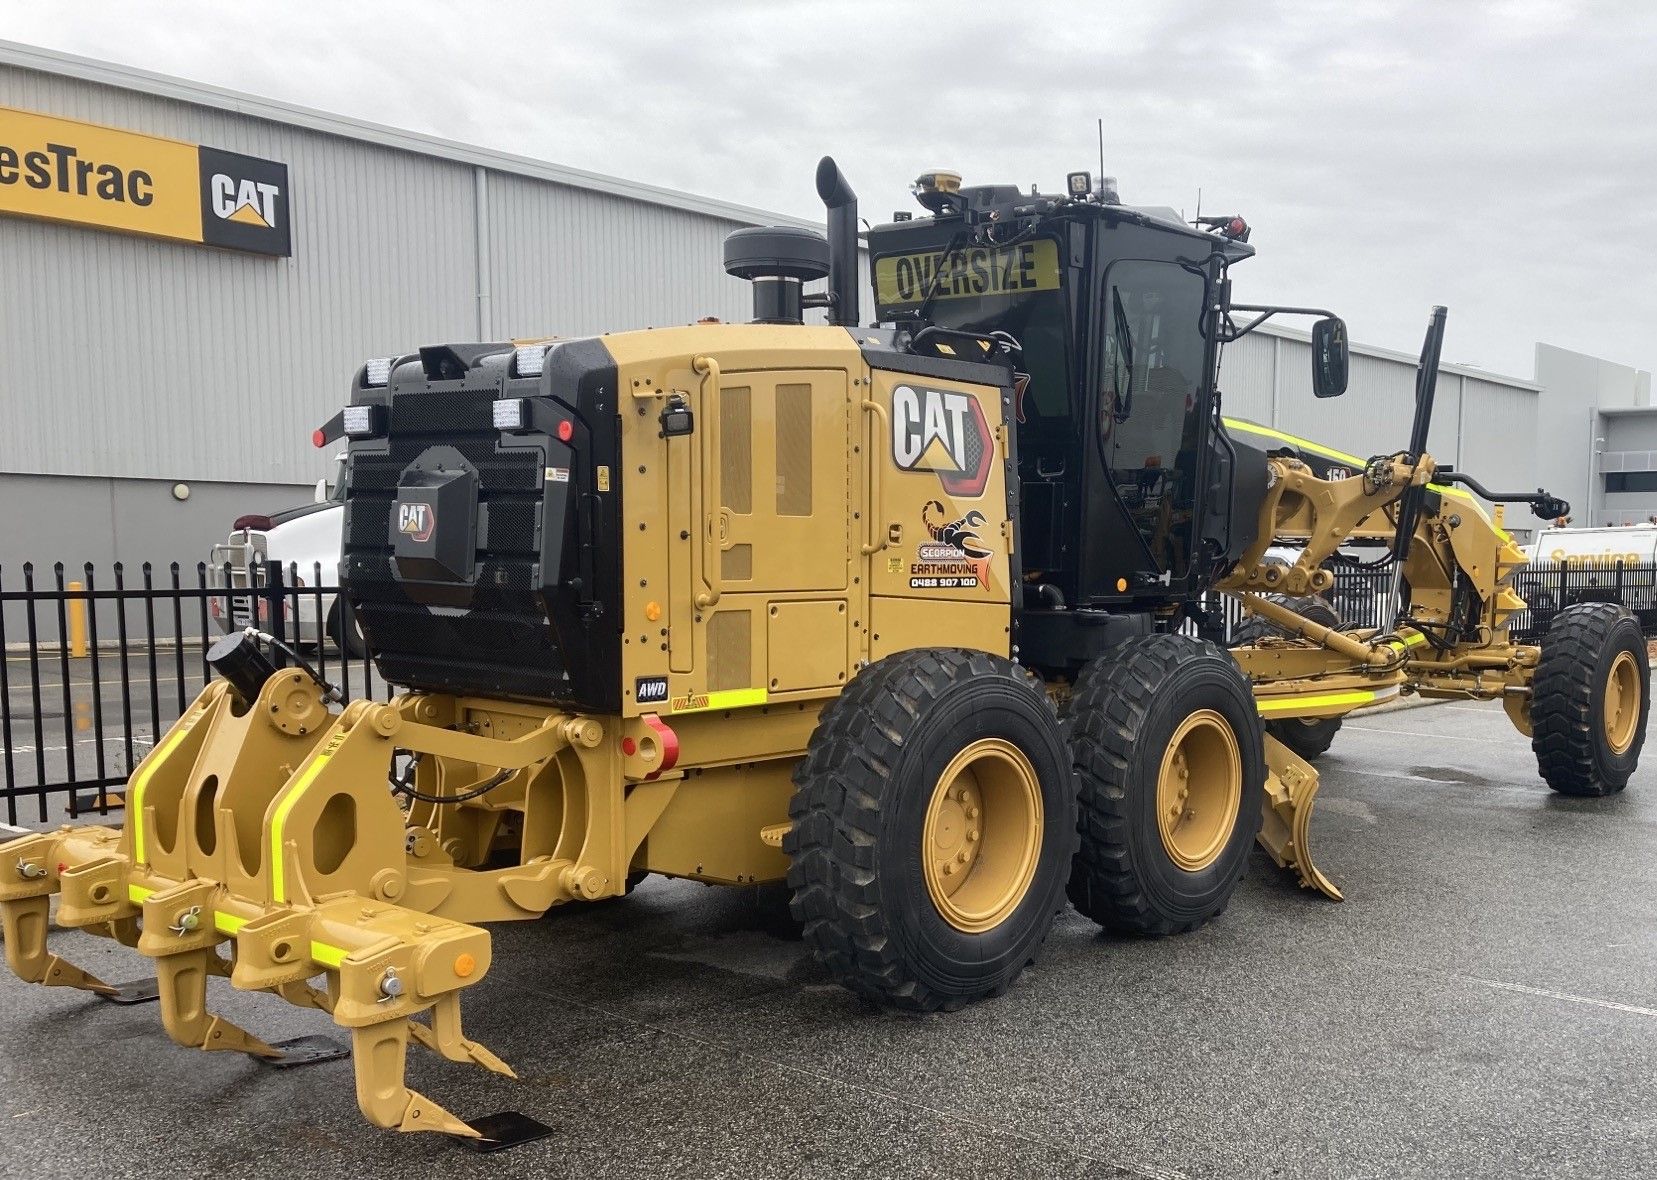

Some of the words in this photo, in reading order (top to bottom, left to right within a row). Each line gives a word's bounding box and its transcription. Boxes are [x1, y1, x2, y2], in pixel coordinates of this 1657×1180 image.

[210, 173, 279, 228] CAT
[896, 244, 1037, 300] OVERSIZE
[893, 386, 968, 472] CAT
[399, 504, 426, 532] CAT
[922, 549, 965, 558] SCORPION
[911, 563, 978, 575] EARTHMOVING
[911, 578, 938, 587] 0488
[939, 578, 958, 587] 907
[960, 578, 976, 586] 100
[638, 682, 667, 697] AWD
